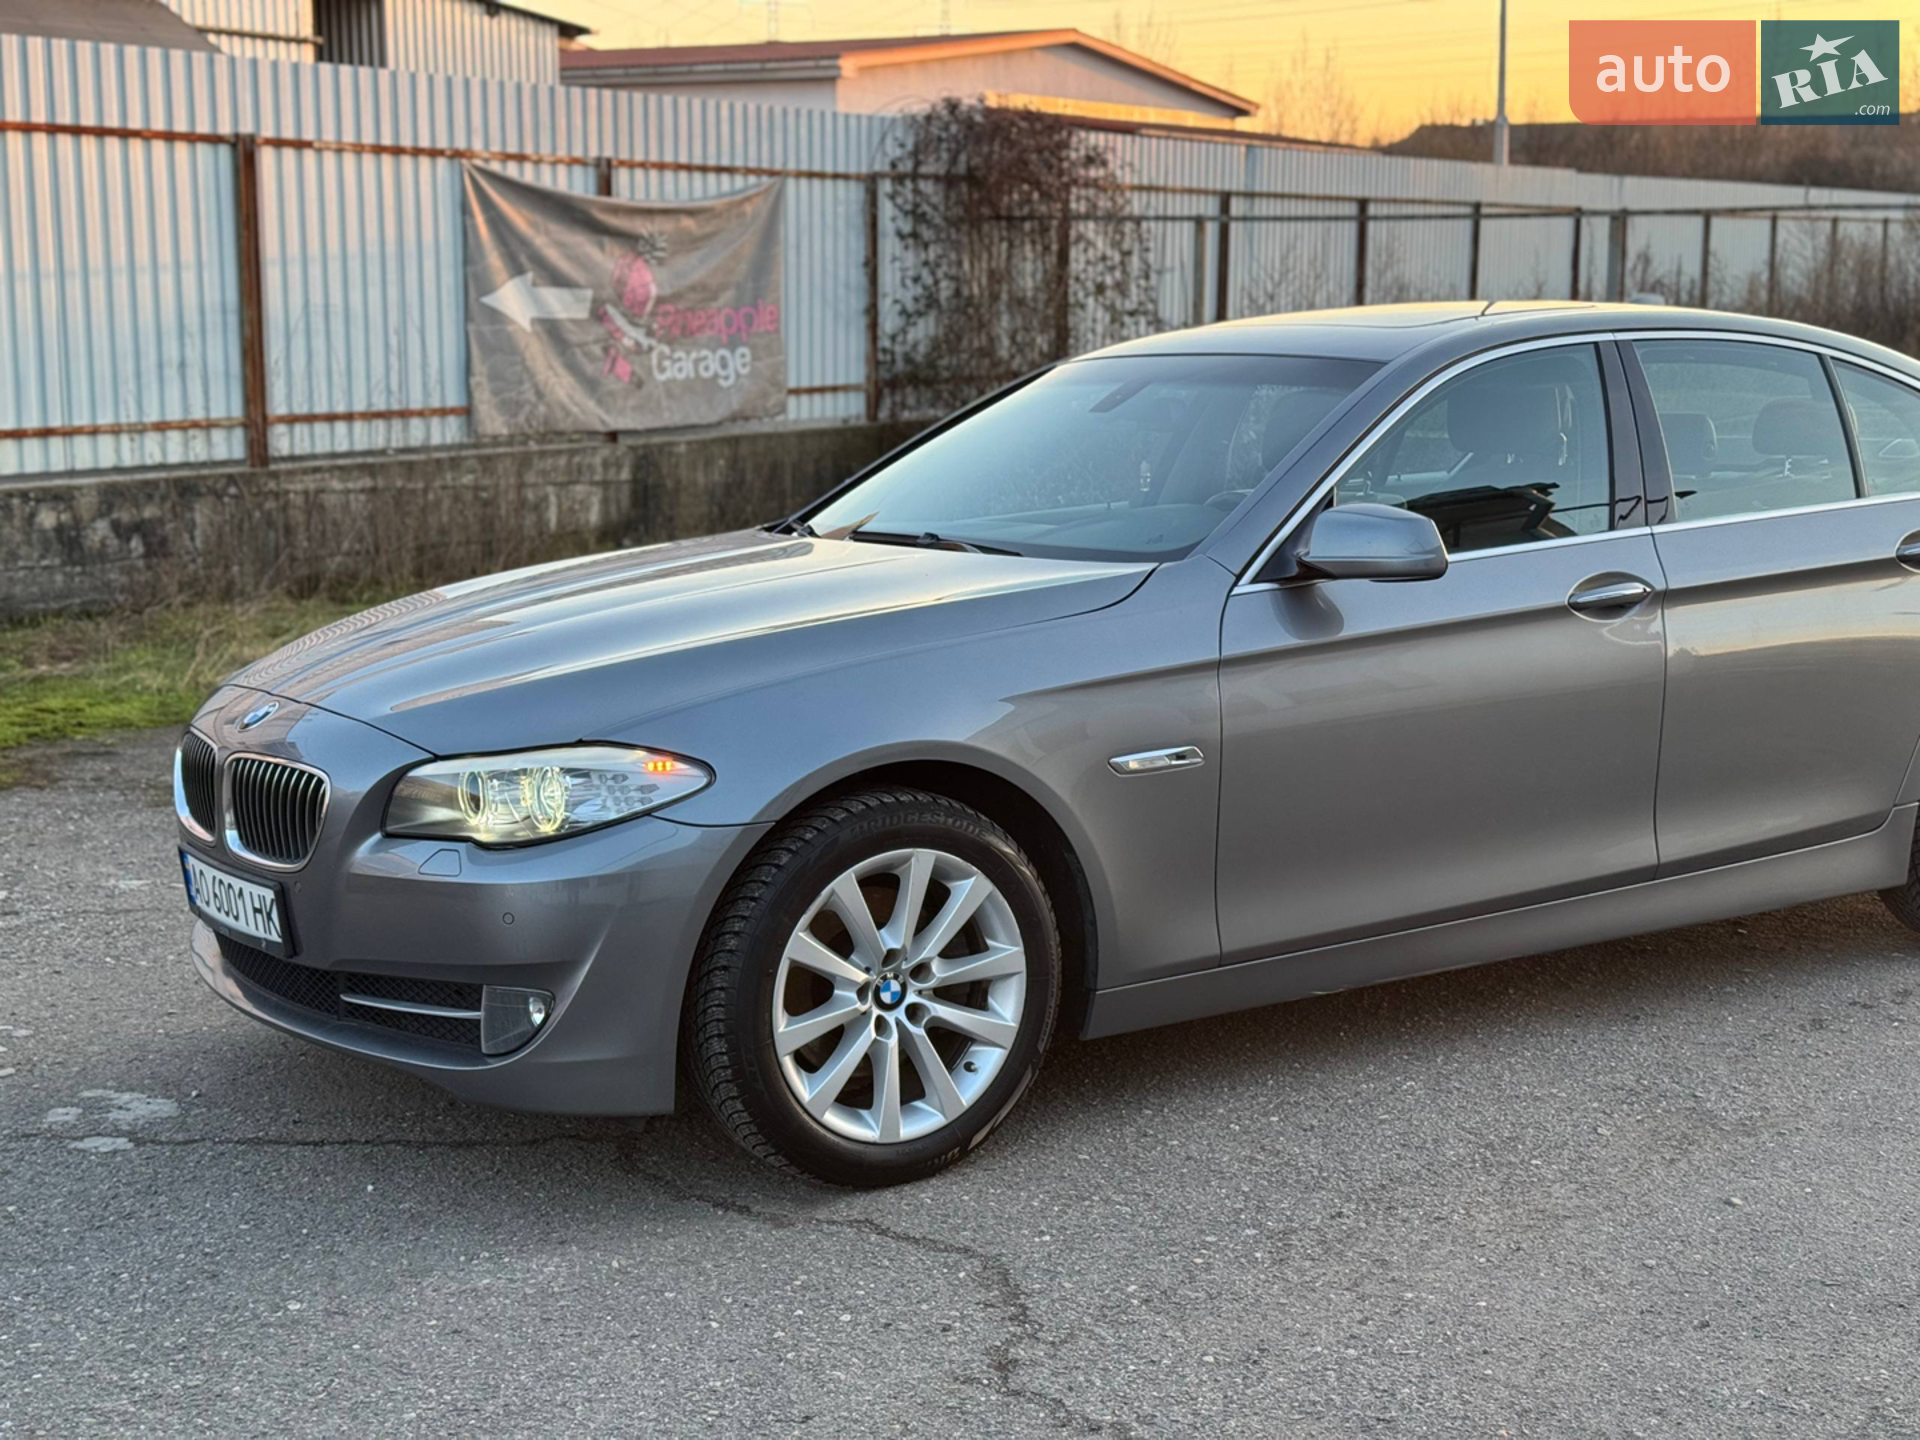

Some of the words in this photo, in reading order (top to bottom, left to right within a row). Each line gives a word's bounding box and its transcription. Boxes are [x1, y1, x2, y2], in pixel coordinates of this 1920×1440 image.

[656, 297, 779, 344] Pineapple
[651, 344, 751, 388] Garage
[192, 864, 210, 907] AO
[212, 875, 249, 927] 6001
[250, 891, 282, 939] HK
